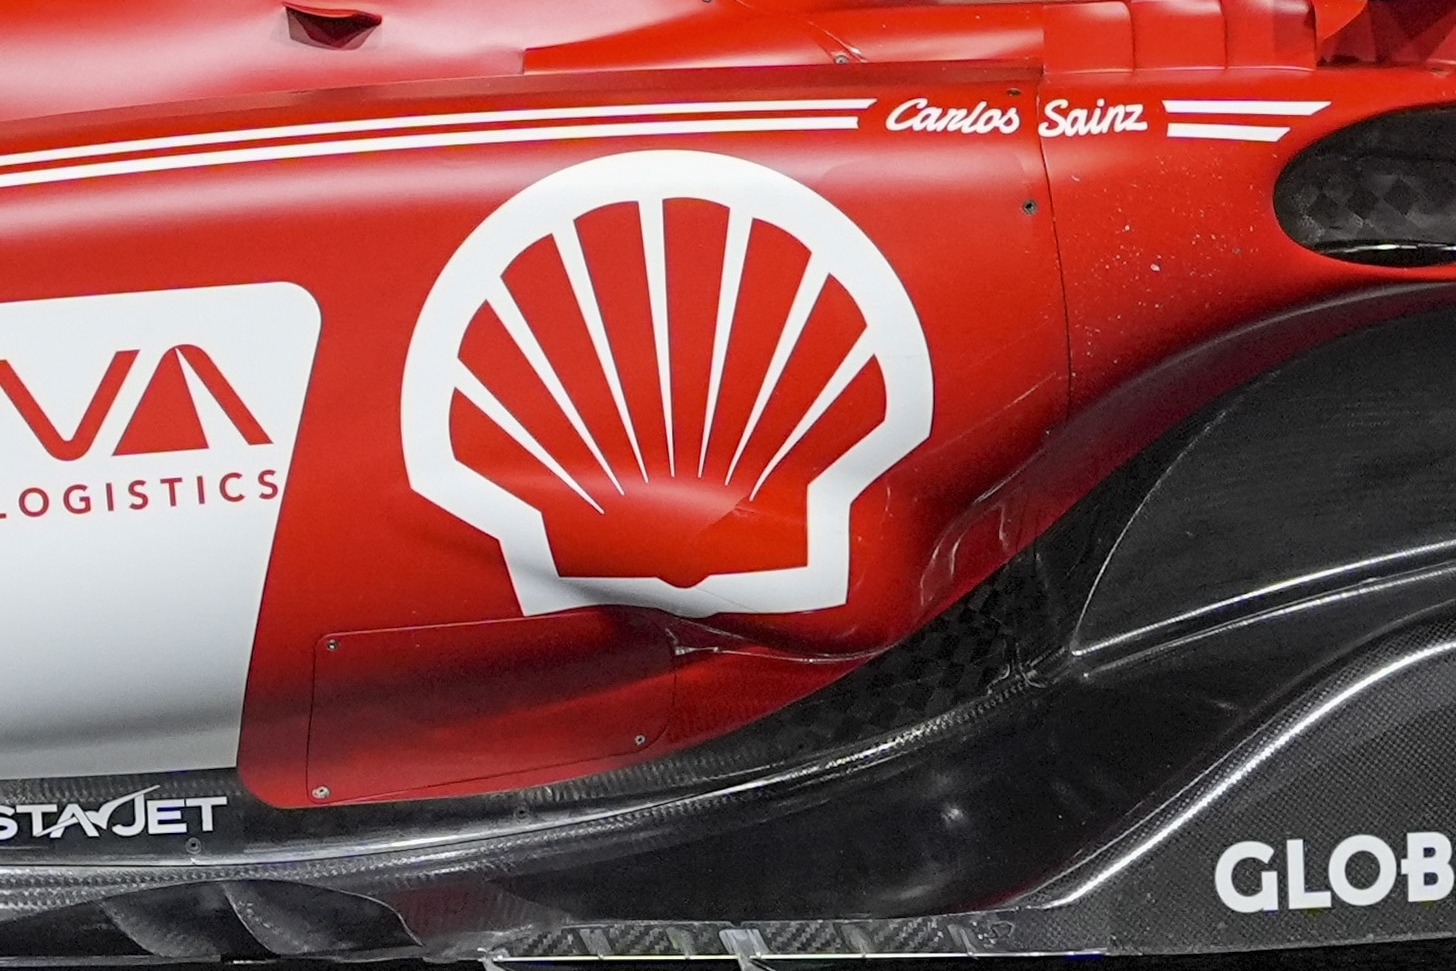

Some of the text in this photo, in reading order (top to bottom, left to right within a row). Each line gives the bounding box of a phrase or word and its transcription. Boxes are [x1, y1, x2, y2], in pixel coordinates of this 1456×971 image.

[885, 97, 1149, 137] Carlos Sainz
[0, 469, 279, 519] OGISTICS
